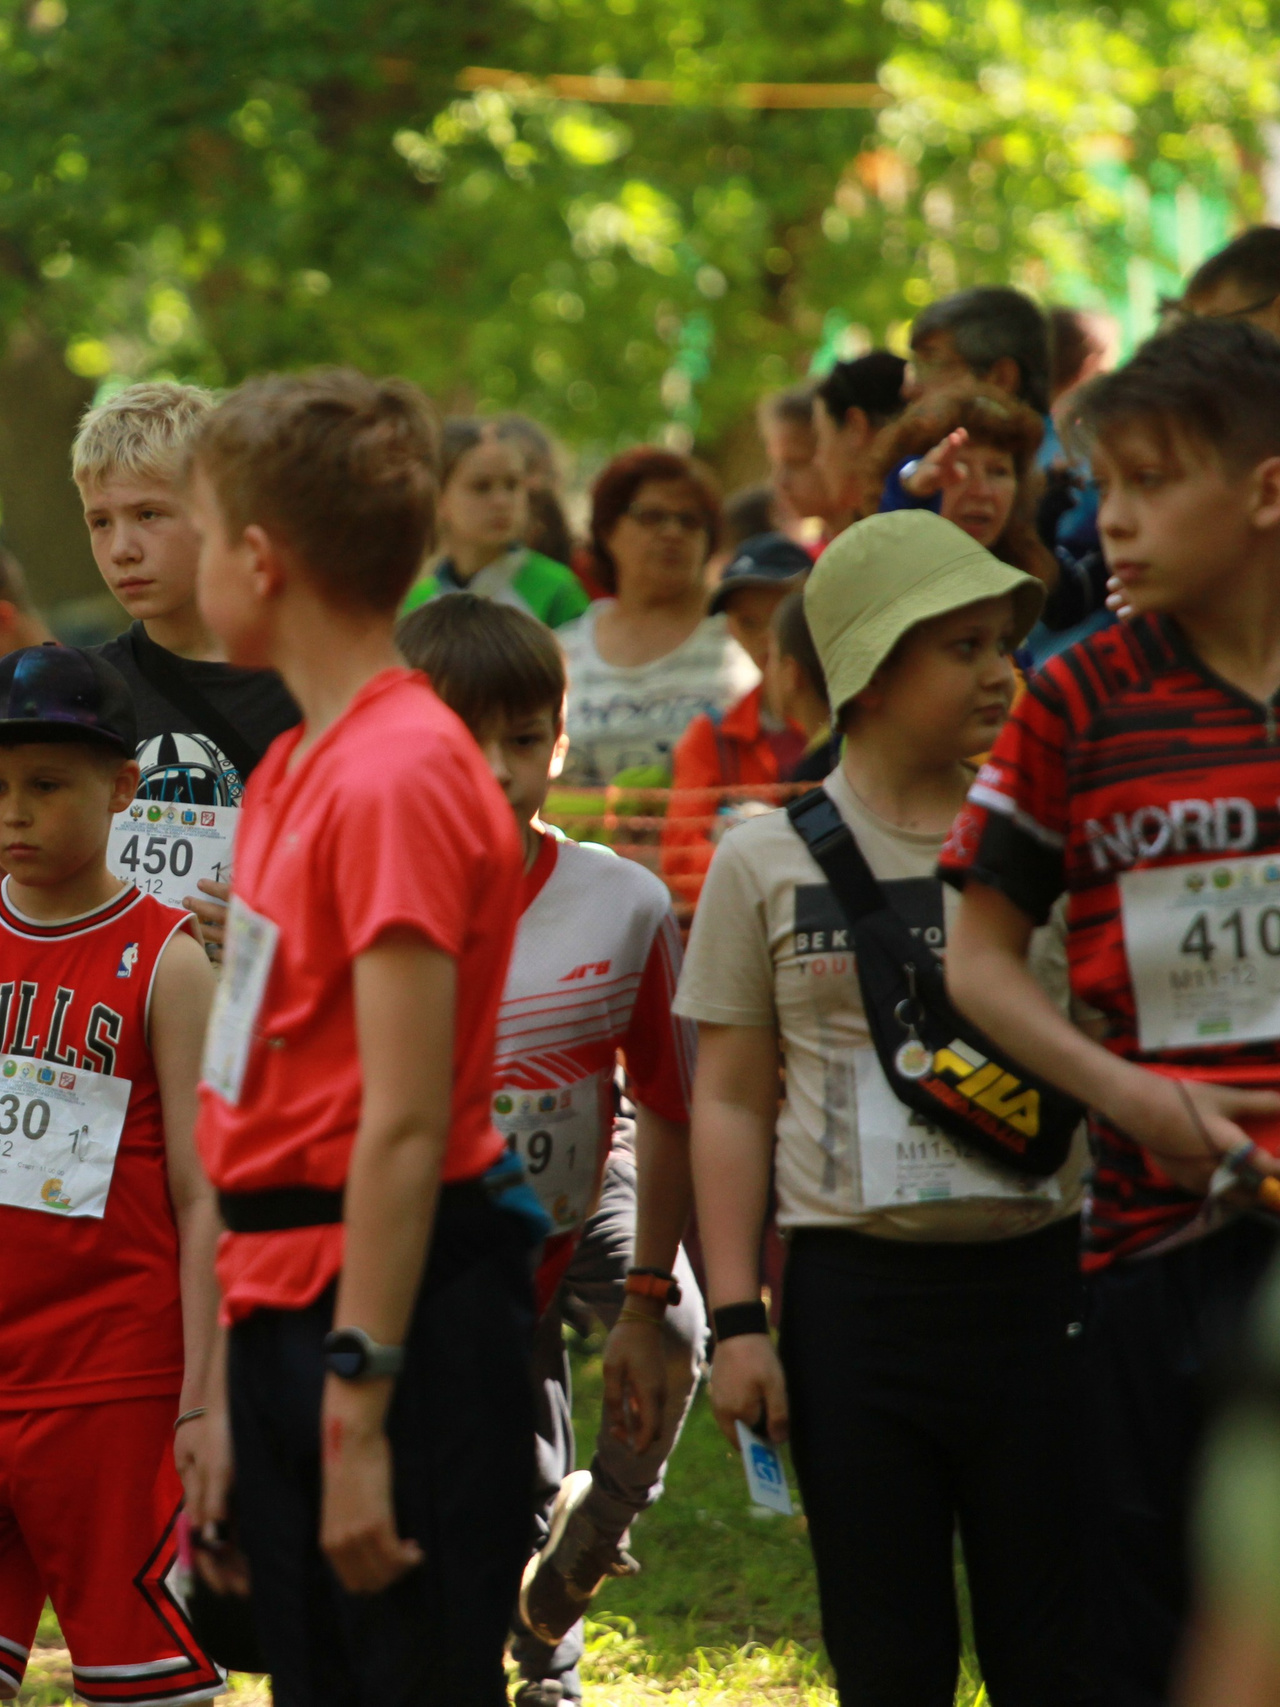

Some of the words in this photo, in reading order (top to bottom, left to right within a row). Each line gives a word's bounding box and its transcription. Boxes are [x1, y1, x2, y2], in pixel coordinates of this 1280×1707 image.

[119, 835, 193, 877] 450
[1084, 797, 1258, 870] NORD
[211, 862, 221, 882] 1
[1180, 909, 1280, 962] 410
[931, 1037, 1041, 1138] FILA
[68, 1129, 80, 1154] 1
